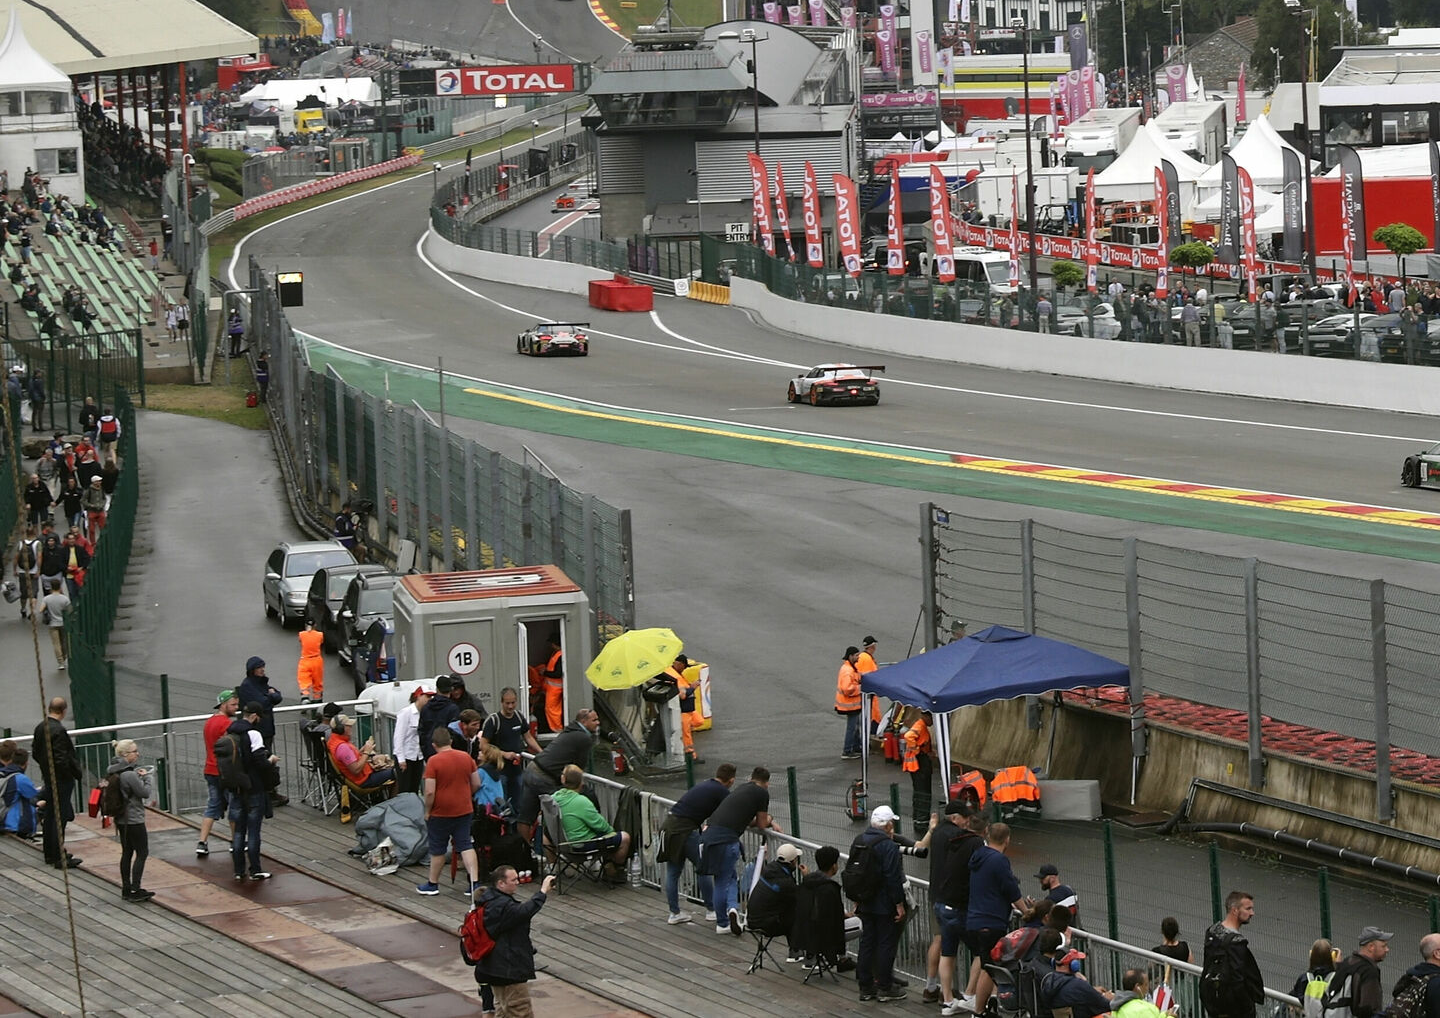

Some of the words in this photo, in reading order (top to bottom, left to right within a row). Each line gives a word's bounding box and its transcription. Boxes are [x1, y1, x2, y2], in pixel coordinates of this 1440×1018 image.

[466, 70, 565, 91] TOTAL
[731, 224, 743, 232] PIT
[726, 233, 749, 241] ENTRY
[994, 234, 1009, 245] TOTA
[1050, 242, 1071, 253] TOTAL
[1111, 249, 1132, 262] TOTAL
[1142, 253, 1159, 265] TOTA
[455, 652, 472, 666] 1B
